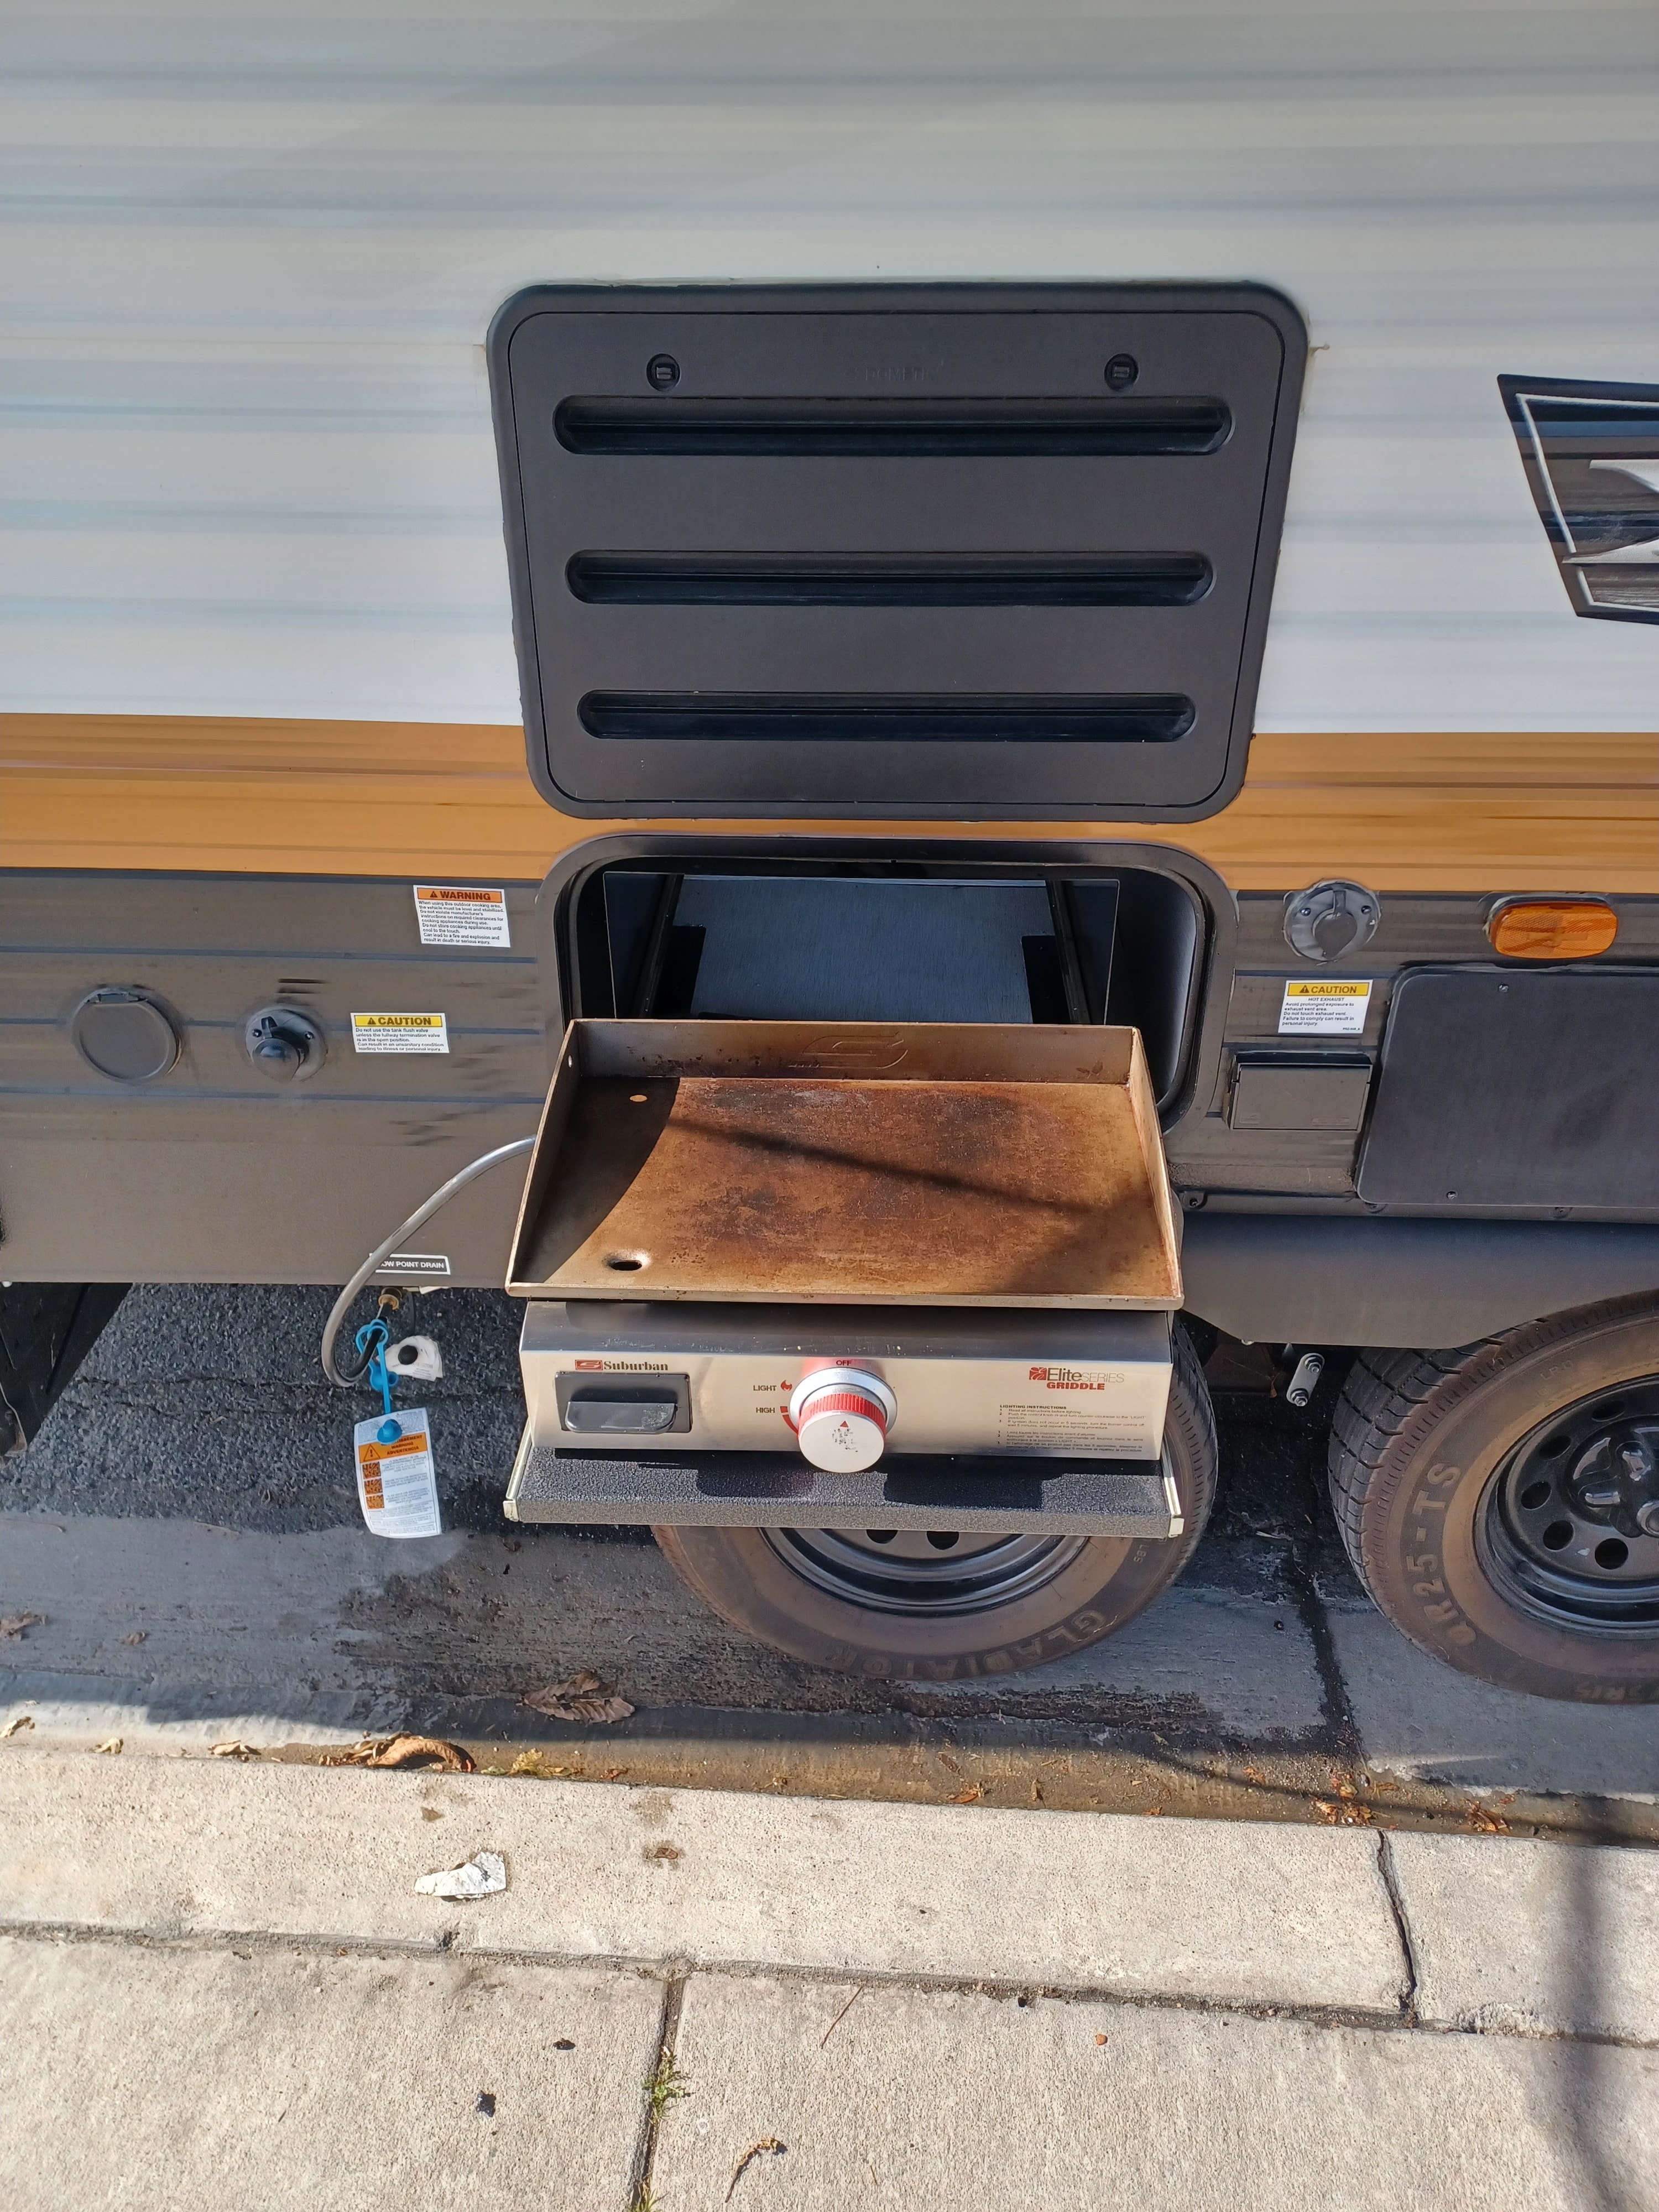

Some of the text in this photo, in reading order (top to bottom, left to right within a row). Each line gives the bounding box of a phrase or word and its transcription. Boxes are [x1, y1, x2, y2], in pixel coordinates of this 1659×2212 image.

[440, 891, 491, 900] WARNING
[378, 1017, 431, 1025] CAUTION
[604, 1361, 668, 1371] Suburban
[1133, 1544, 1149, 1564] LBS
[825, 1610, 1106, 1679] GLADIATOR
